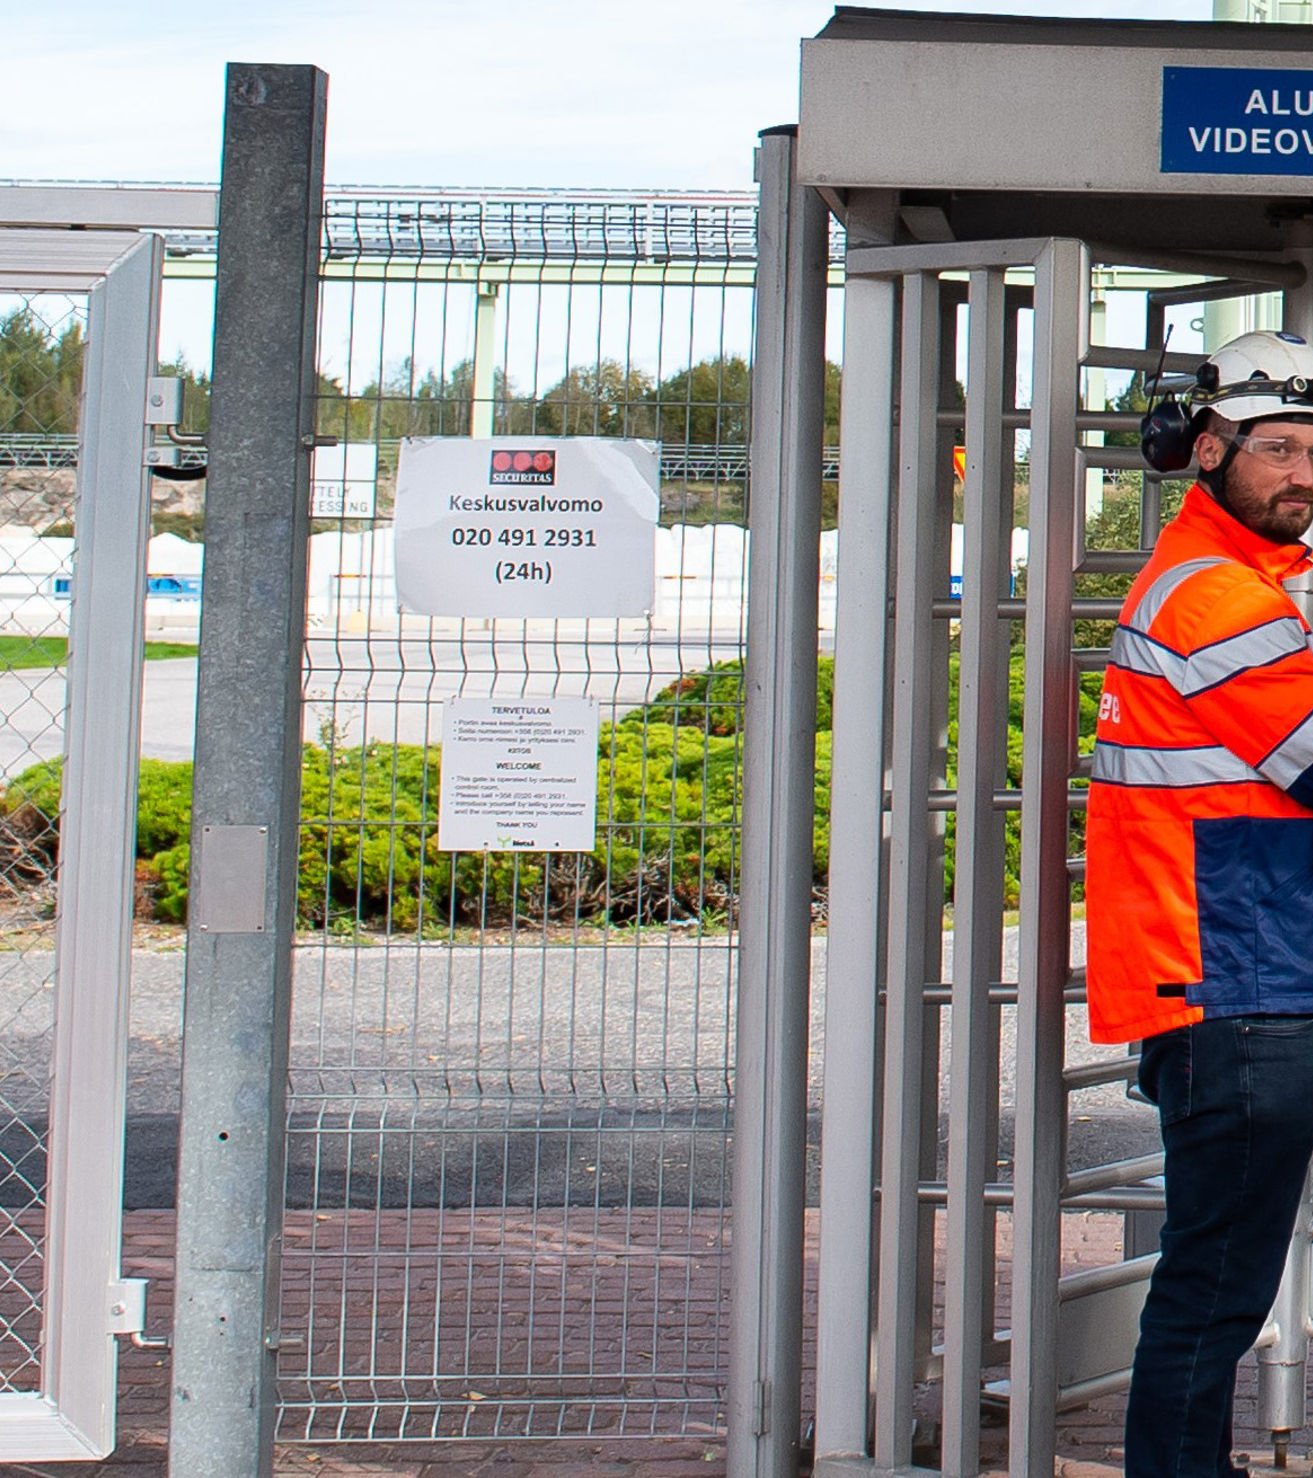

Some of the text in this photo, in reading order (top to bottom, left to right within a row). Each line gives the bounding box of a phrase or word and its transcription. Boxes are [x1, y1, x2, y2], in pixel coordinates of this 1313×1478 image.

[492, 473, 553, 483] SECURITAS
[449, 495, 603, 513] Keskusvalvomo
[452, 528, 597, 548] 020 491 2931
[495, 561, 552, 584] (24h)
[491, 706, 551, 716] TERVETULOA
[496, 762, 542, 770] WELCOME
[472, 776, 488, 784] gate
[497, 776, 527, 784] operated
[496, 821, 521, 829] THANK
